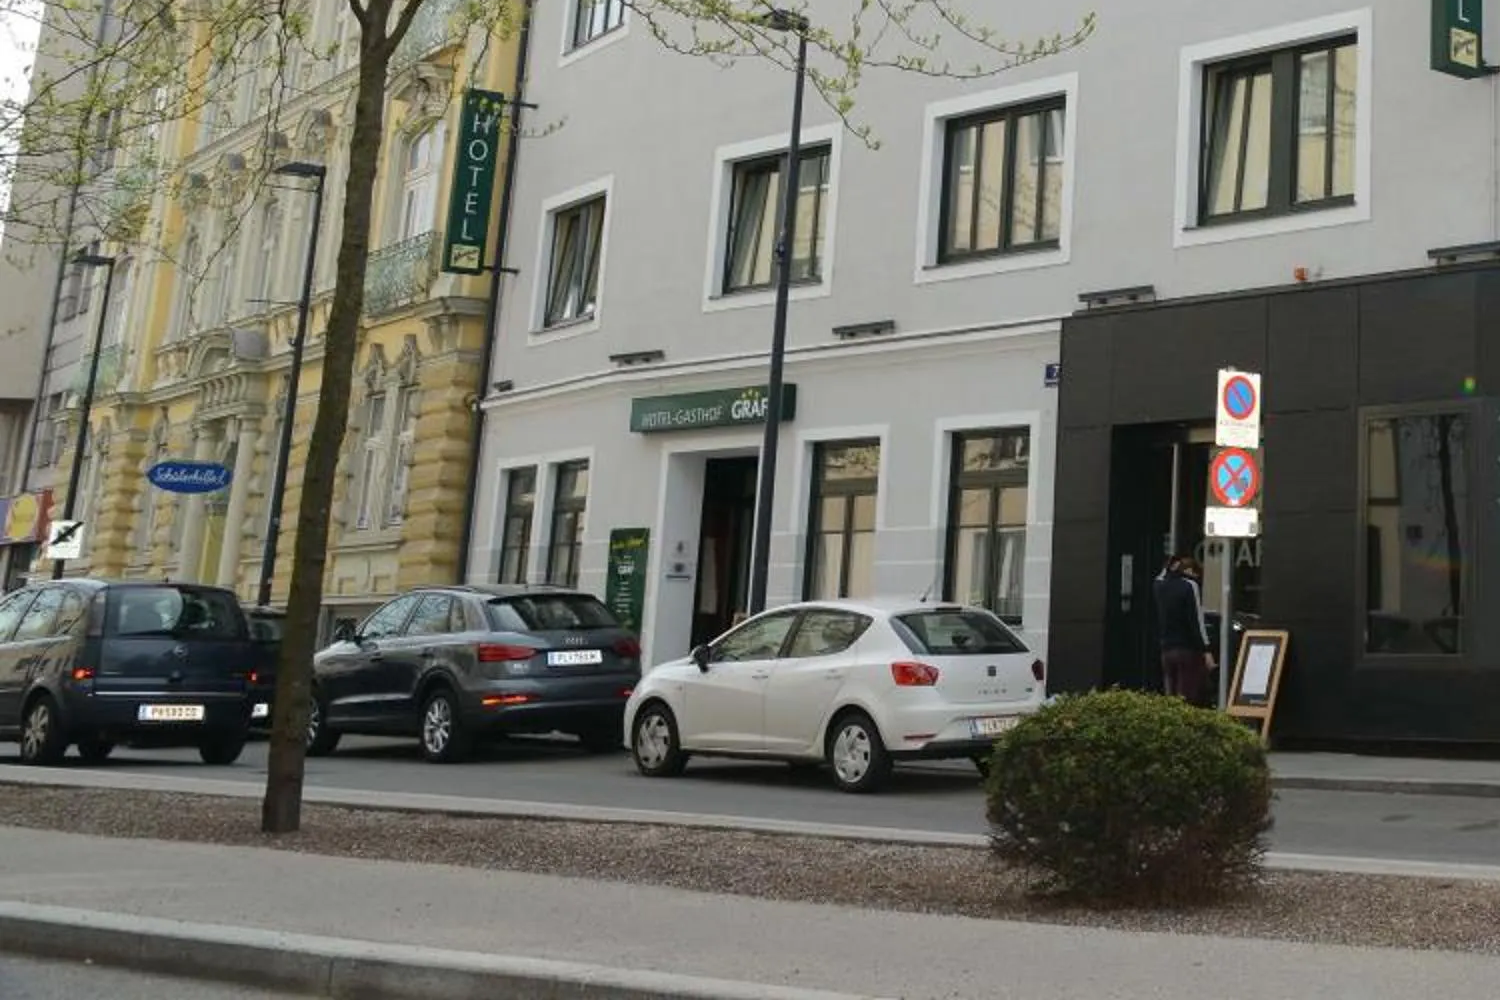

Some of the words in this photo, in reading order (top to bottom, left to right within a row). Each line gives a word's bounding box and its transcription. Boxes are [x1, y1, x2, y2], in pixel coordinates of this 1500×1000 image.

[461, 113, 493, 241] HOTEL
[641, 405, 723, 428] HOTEL-GASTHOF
[731, 397, 769, 419] GRAF
